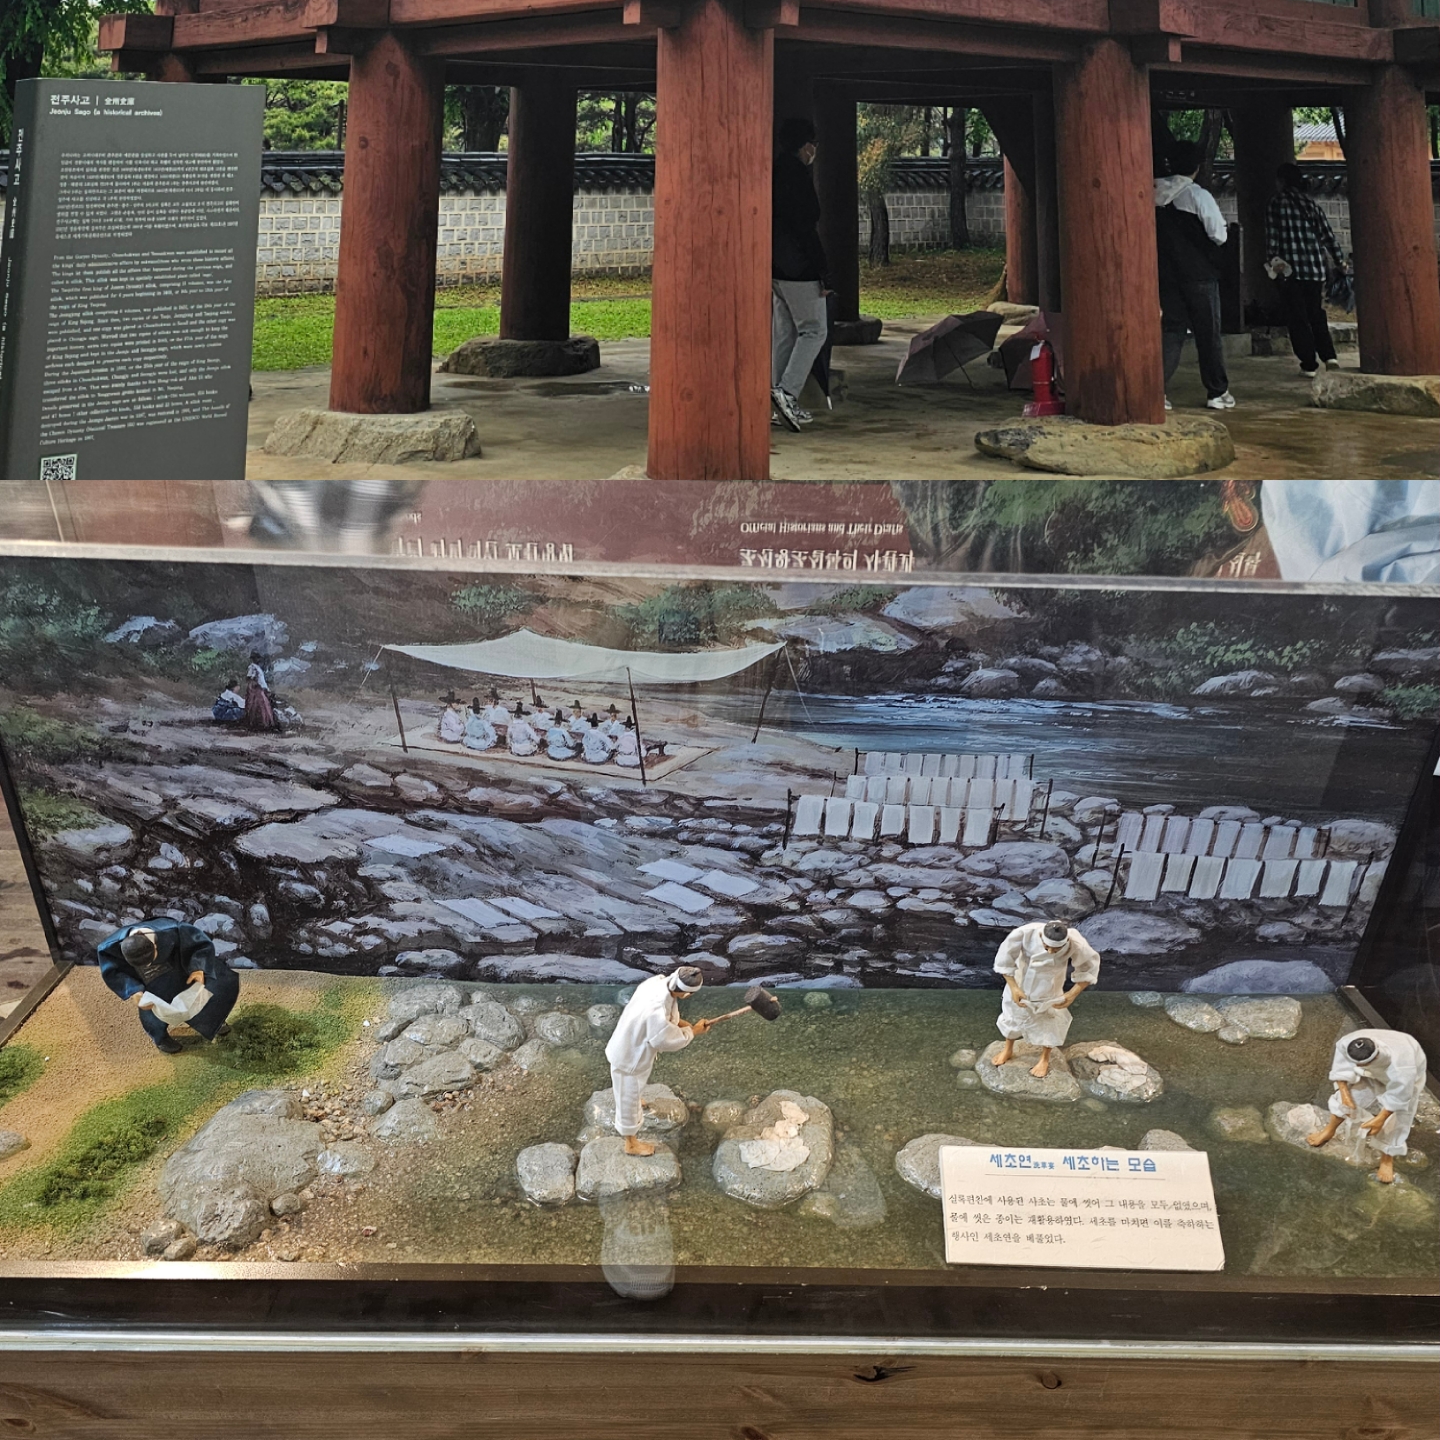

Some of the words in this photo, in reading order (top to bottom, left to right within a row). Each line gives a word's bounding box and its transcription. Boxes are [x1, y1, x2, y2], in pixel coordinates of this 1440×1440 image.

[50, 94, 90, 106] 전주사고
[1128, 1157, 1157, 1172] 모습
[1105, 1199, 1114, 1208] 그
